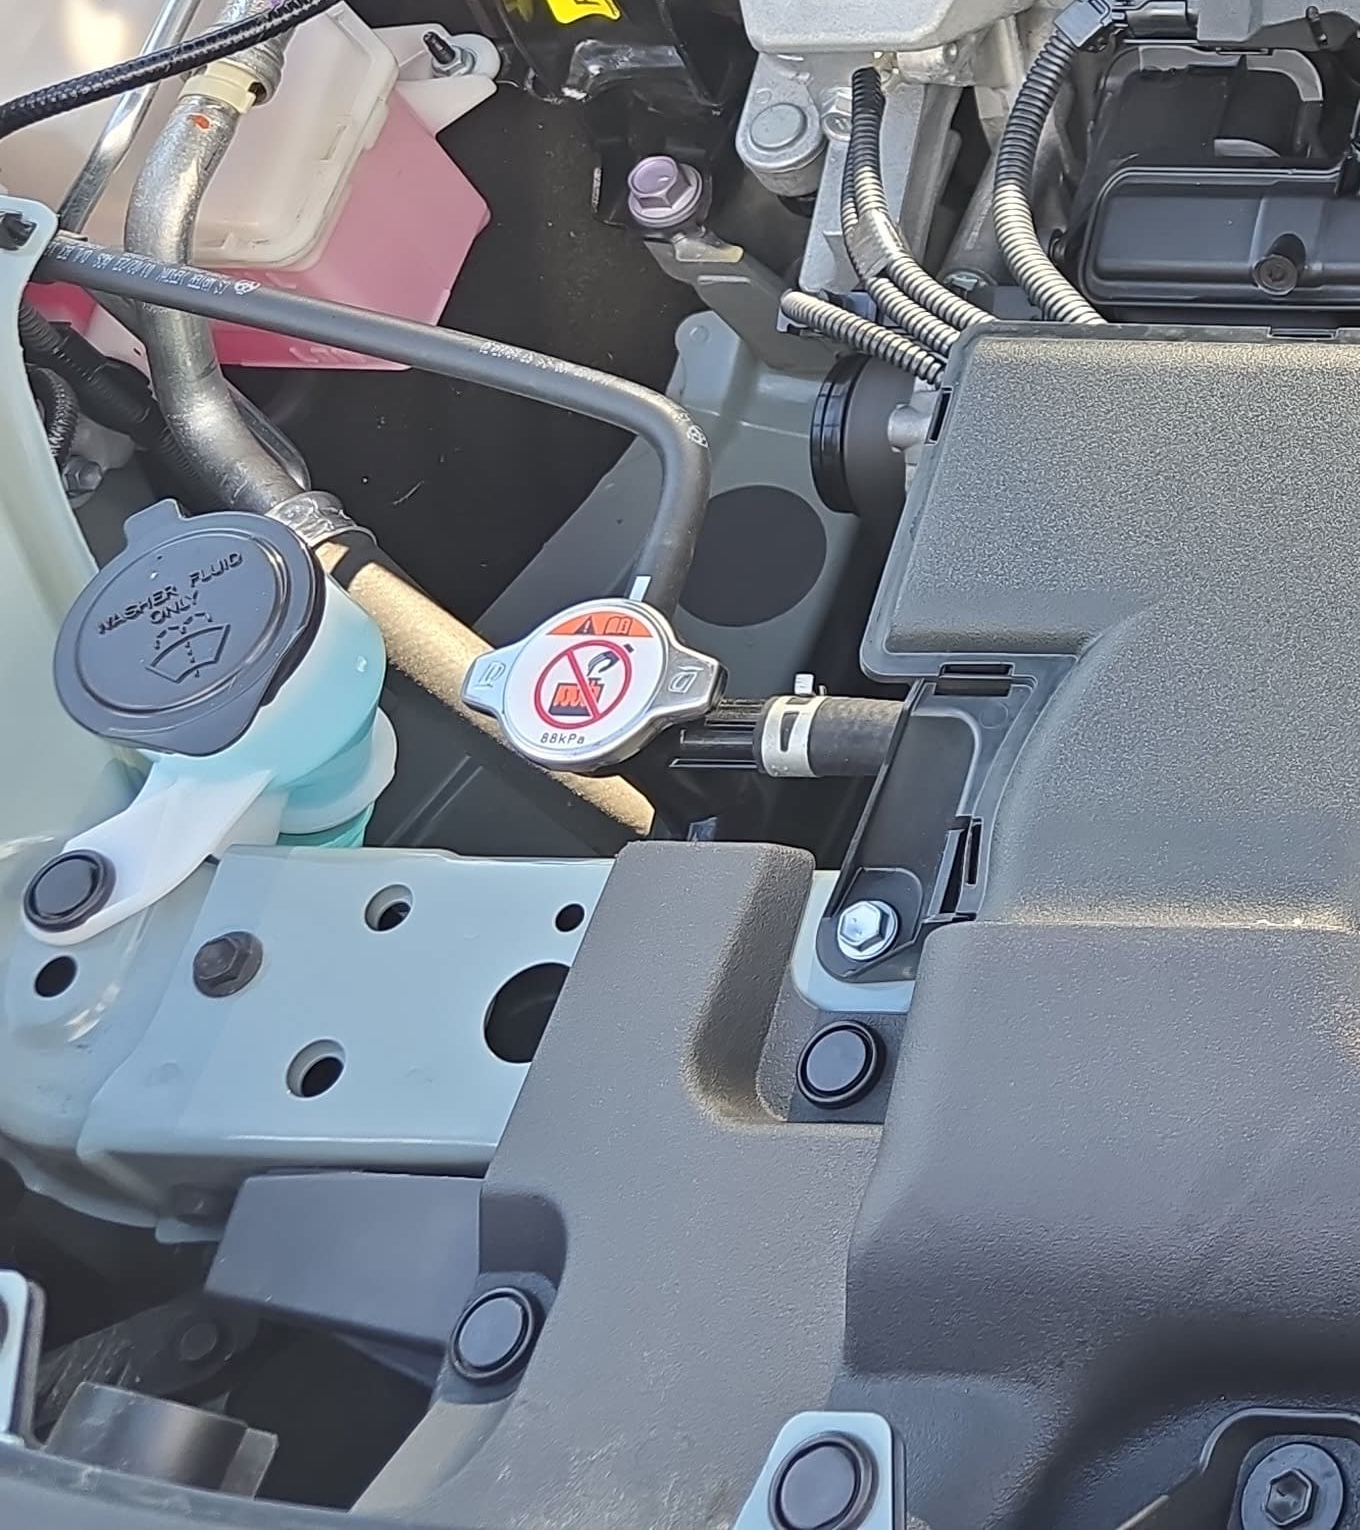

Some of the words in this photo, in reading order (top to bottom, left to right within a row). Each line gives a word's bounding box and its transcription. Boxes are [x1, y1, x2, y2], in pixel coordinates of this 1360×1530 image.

[97, 585, 178, 635] WASHER
[189, 552, 243, 588] FLUID
[150, 590, 199, 625] ONLY
[540, 733, 586, 745] 88kPa
